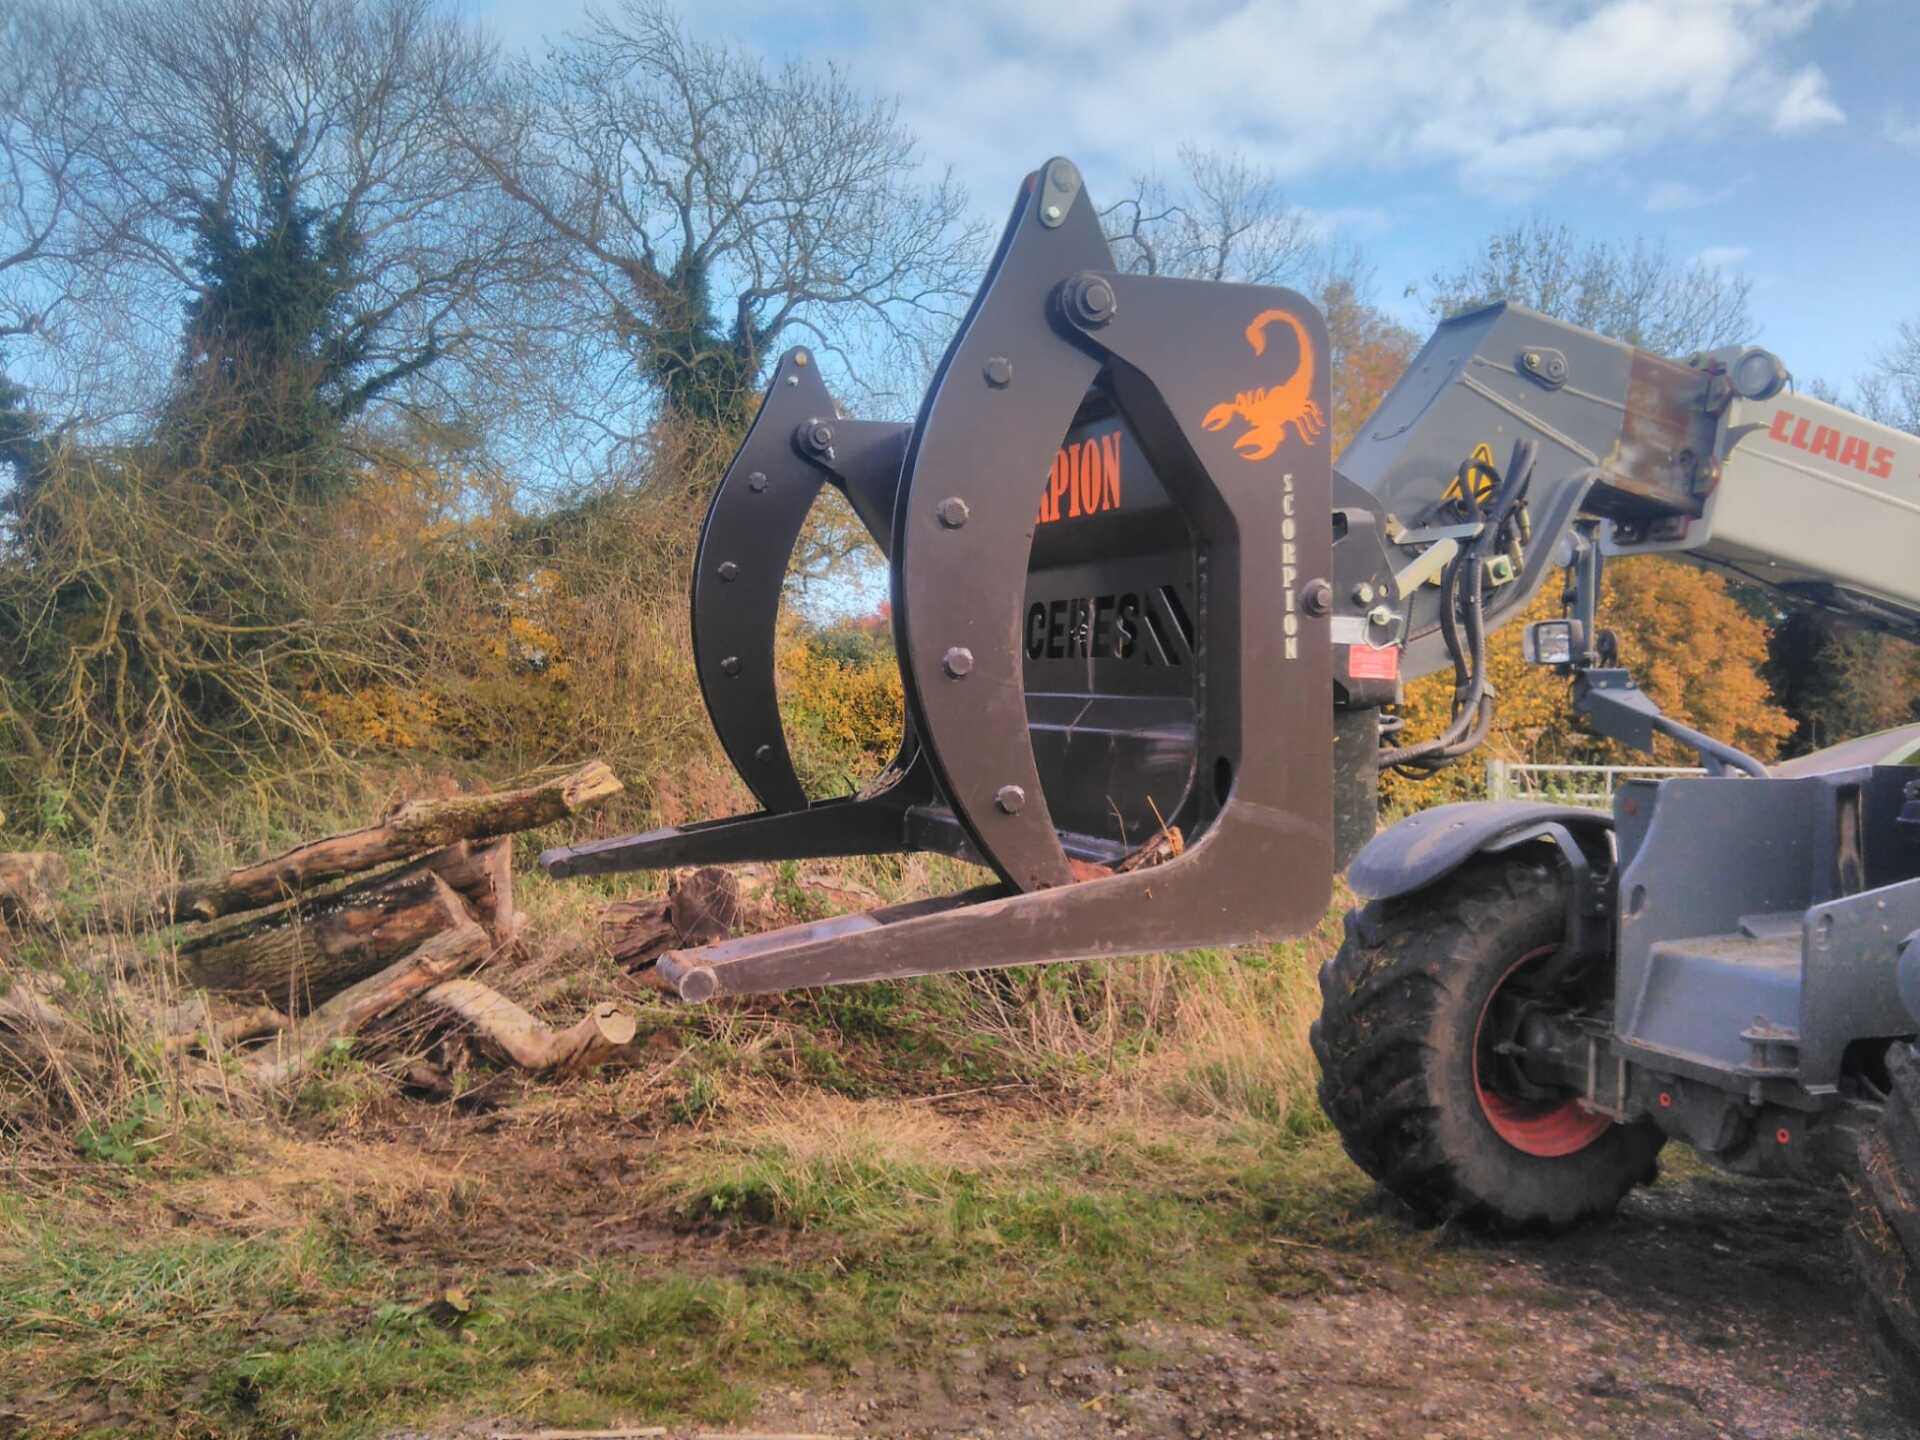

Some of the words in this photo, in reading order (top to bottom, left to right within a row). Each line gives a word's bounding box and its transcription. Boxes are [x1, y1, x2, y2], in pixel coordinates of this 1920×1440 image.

[1769, 410, 1896, 479] CLAAS
[1282, 473, 1298, 660] SCORPION
[1025, 593, 1140, 661] CERES
